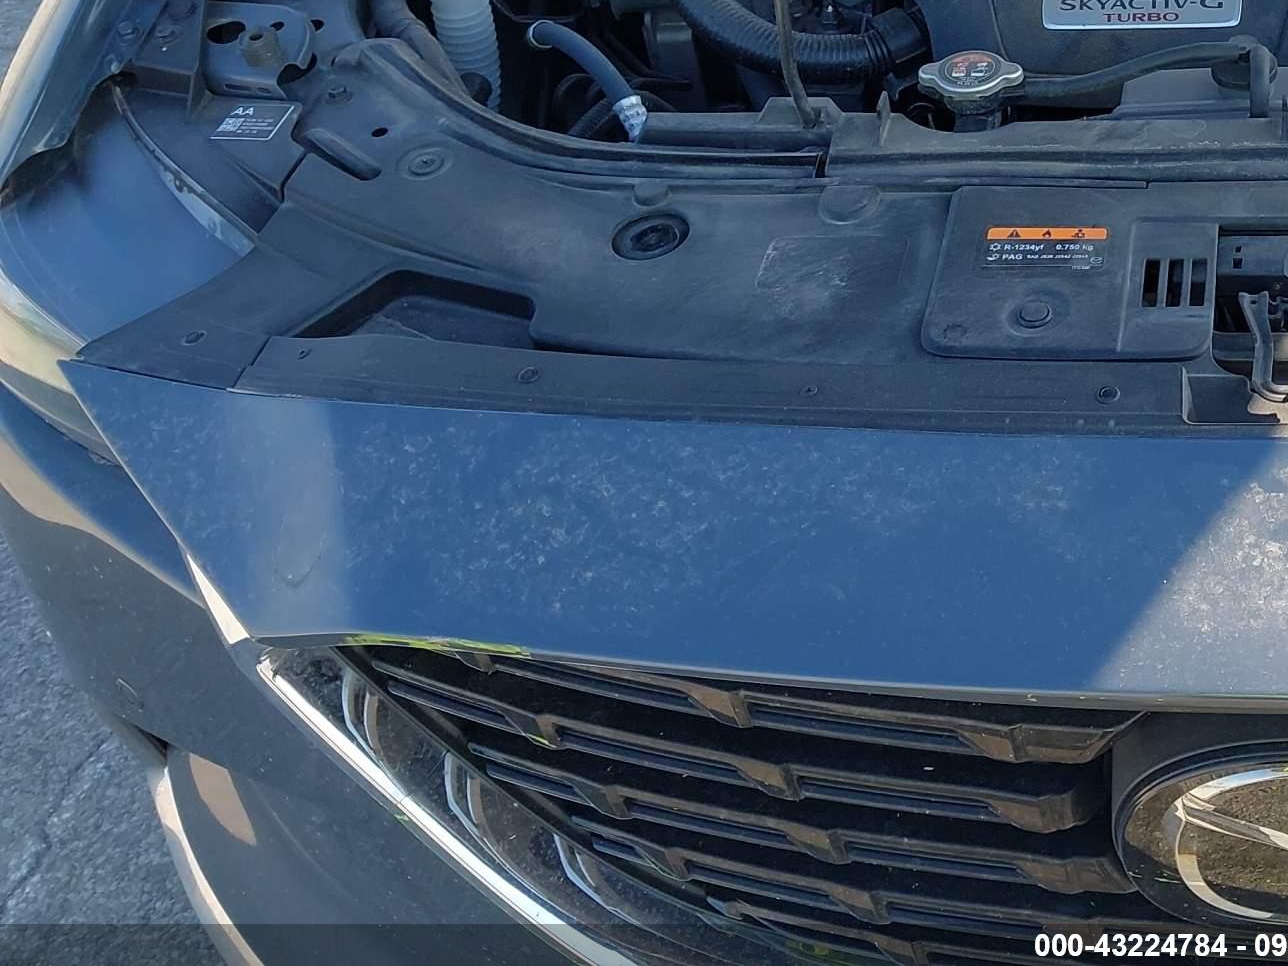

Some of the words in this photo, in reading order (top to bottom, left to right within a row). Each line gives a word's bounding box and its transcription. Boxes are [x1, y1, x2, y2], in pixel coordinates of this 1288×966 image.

[1103, 12, 1179, 23] TURBO
[230, 106, 254, 116] AA
[1003, 244, 1044, 252] R-1234yf
